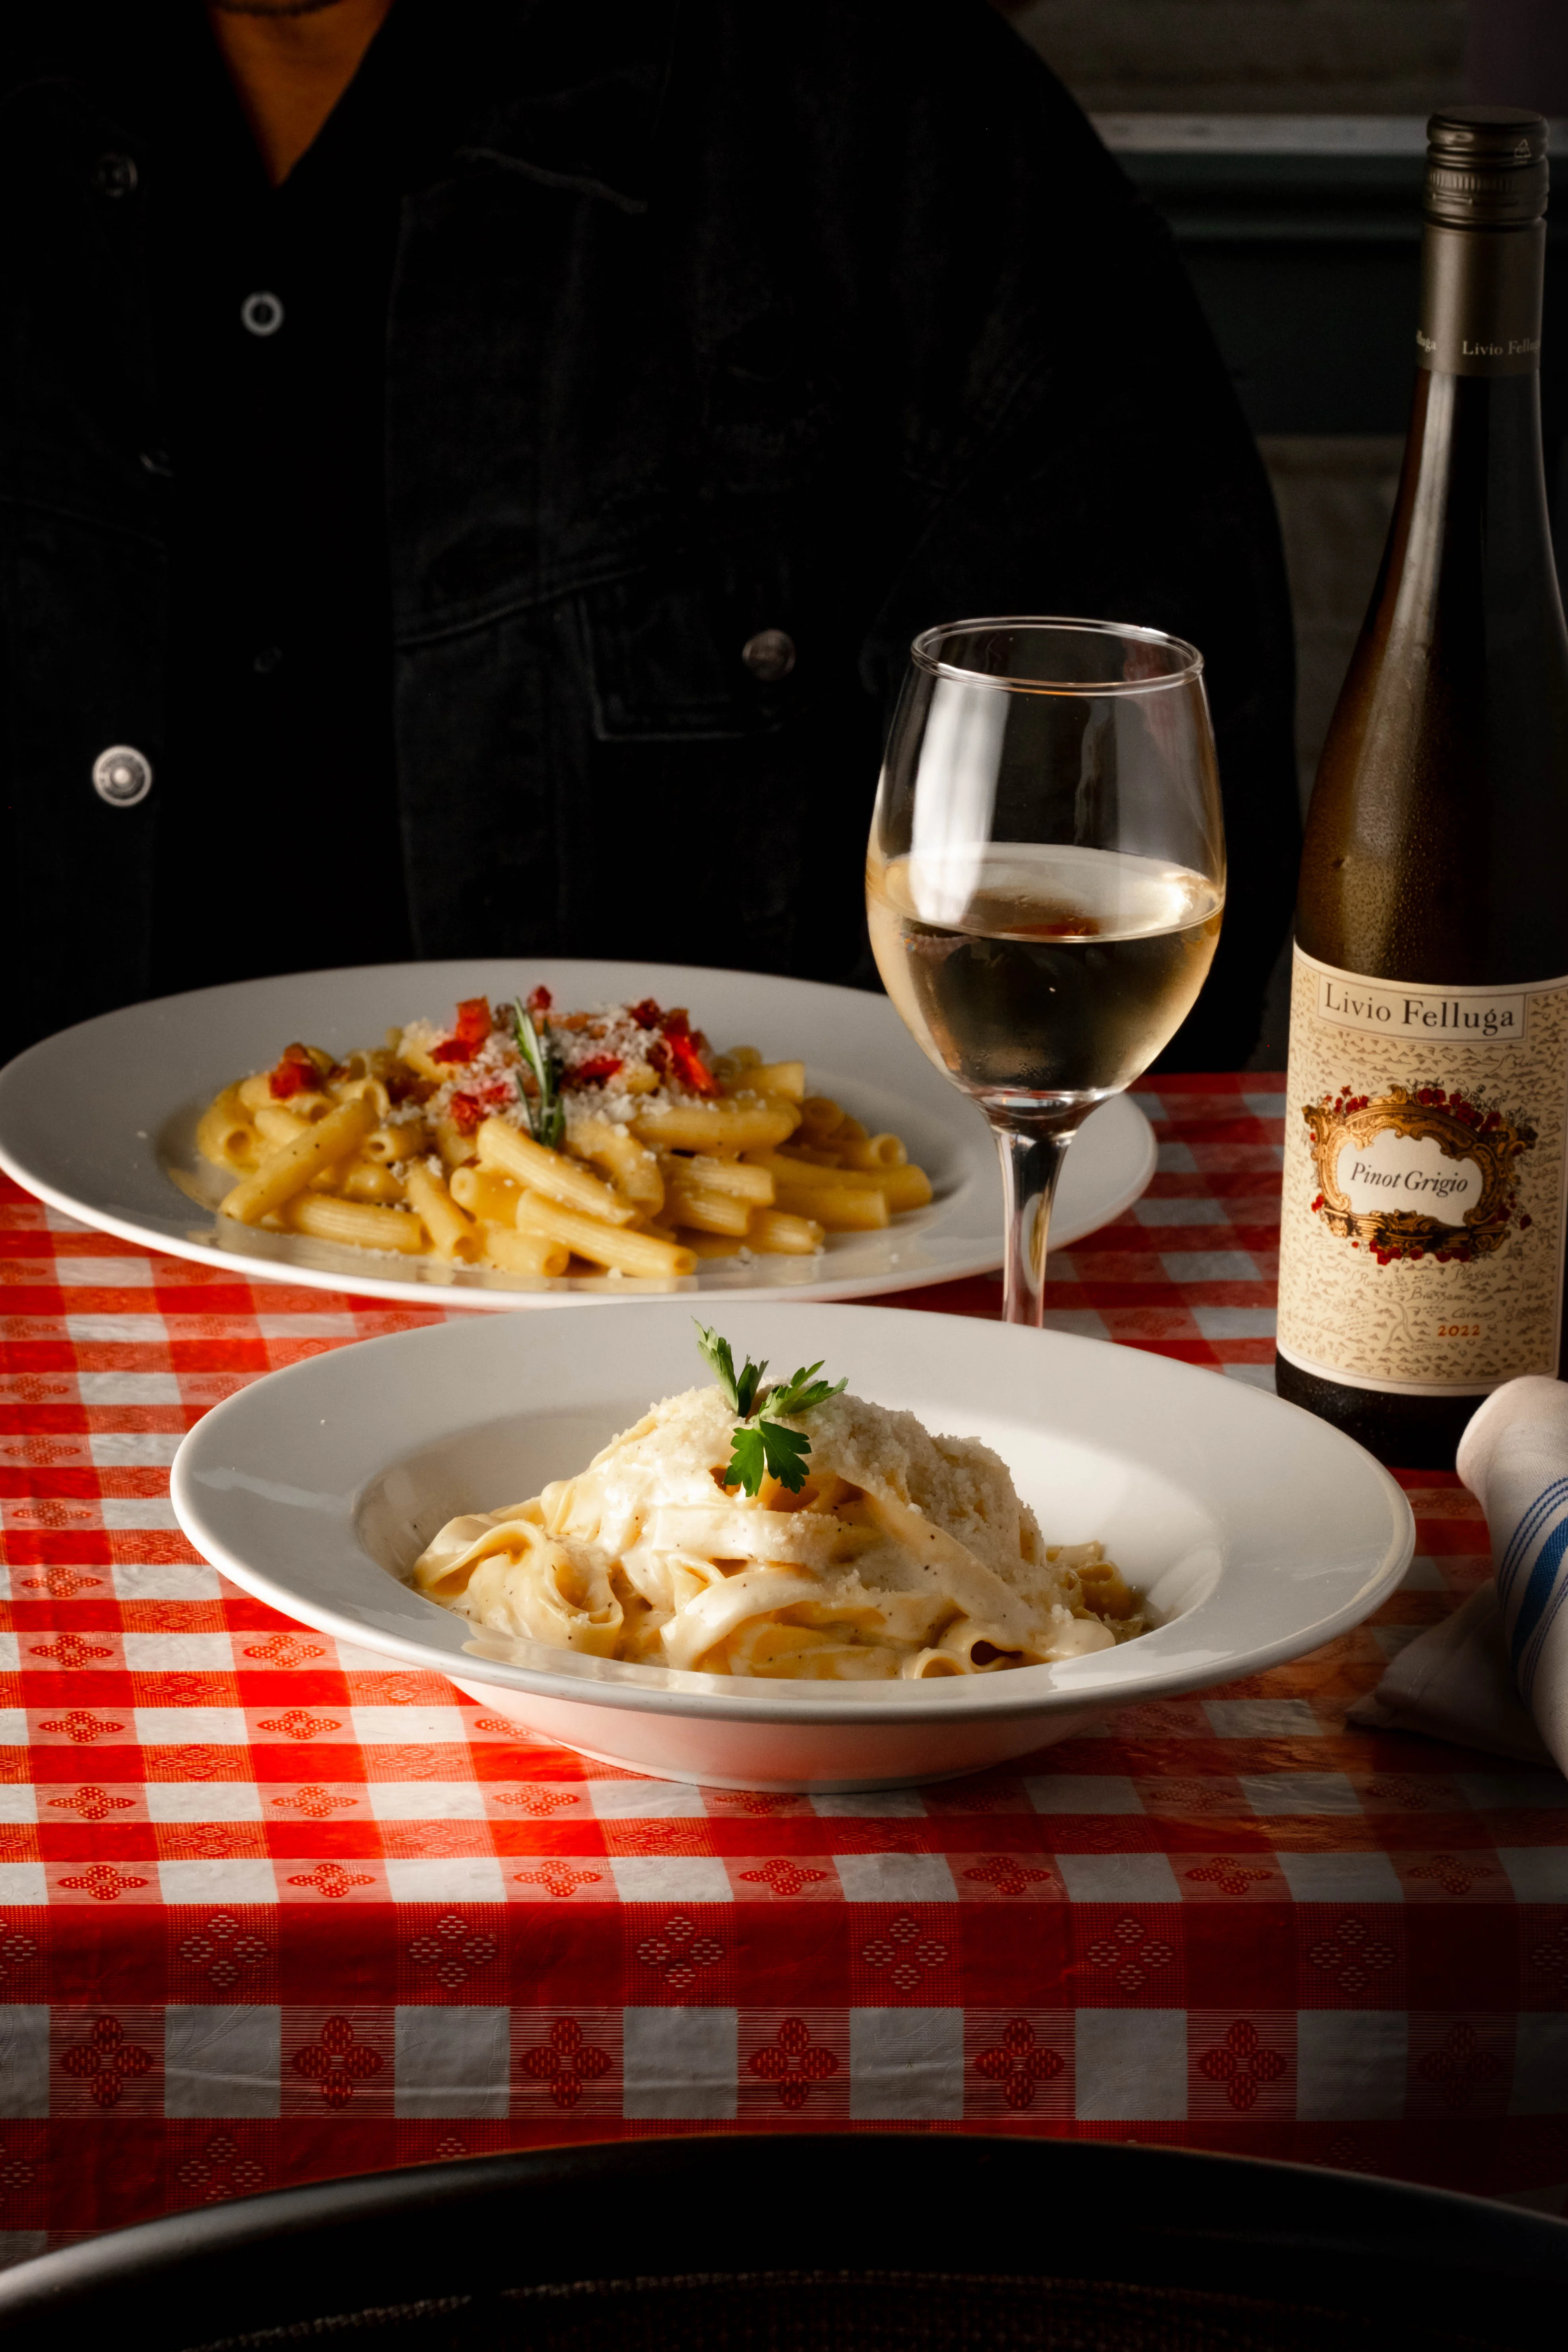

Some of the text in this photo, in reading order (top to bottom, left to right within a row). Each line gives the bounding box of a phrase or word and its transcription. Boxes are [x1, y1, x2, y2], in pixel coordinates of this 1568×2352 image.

[1462, 340, 1503, 355] Livio
[1325, 982, 1515, 1036] Livio Felluga
[1350, 1162, 1469, 1197] Pinot Grigio
[1437, 1324, 1481, 1337] 2022
